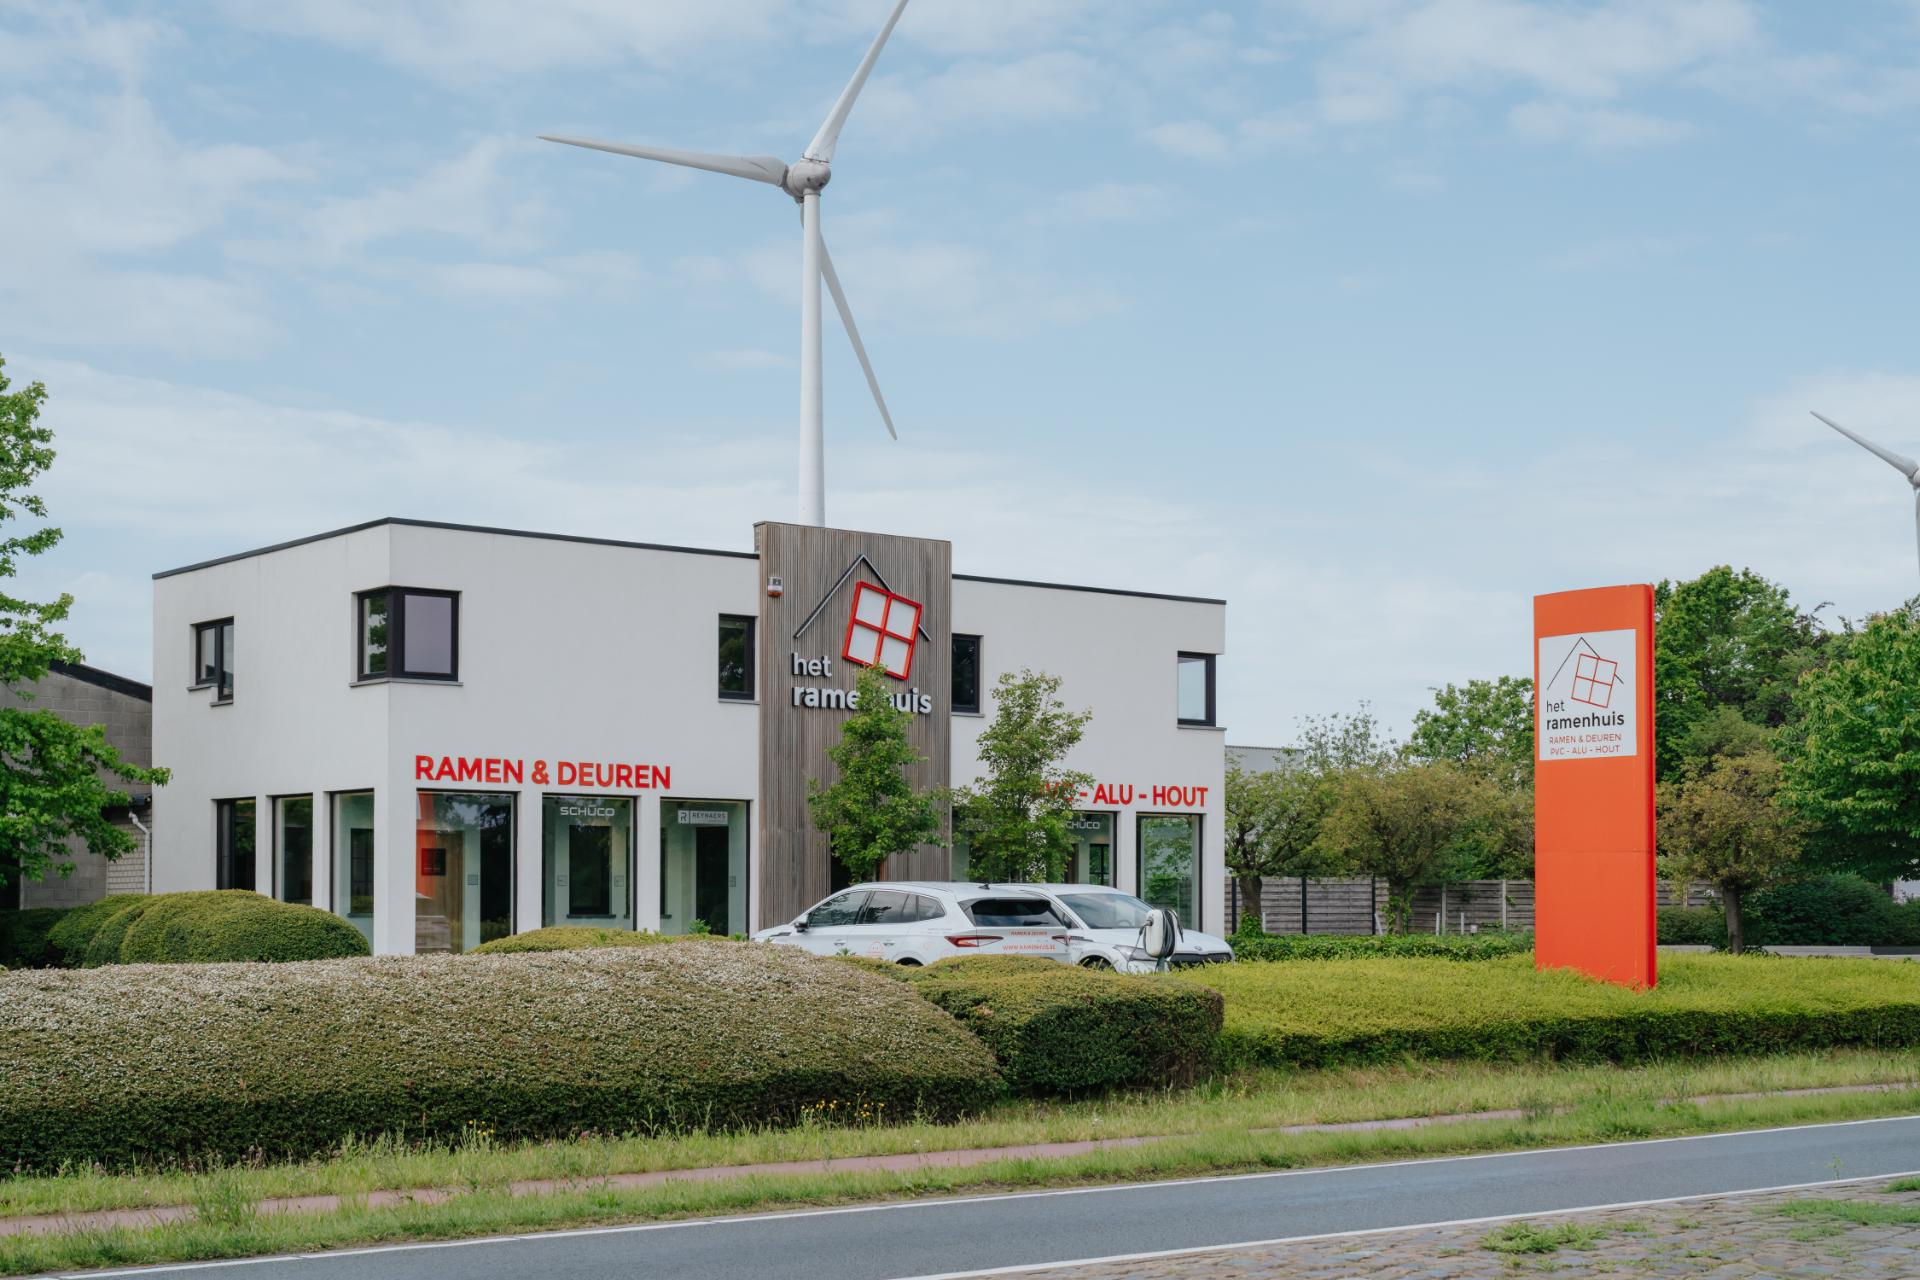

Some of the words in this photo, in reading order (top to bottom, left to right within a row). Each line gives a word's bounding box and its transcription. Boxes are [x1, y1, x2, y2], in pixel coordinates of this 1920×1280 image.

[792, 652, 832, 677] het
[792, 686, 932, 714] rameuis
[1546, 700, 1565, 712] het
[1546, 711, 1624, 730] ramenhuis
[1549, 735, 1576, 744] RAMEN
[1586, 733, 1621, 742] DEUREN
[1550, 747, 1565, 755] PVC
[1572, 746, 1587, 754] ALU
[1596, 745, 1620, 753] HOUT
[415, 755, 523, 784] RAMEN
[531, 759, 550, 785] &
[557, 761, 671, 790] DEUREN
[1092, 783, 1133, 805] ALU
[1152, 785, 1209, 807] HOUT
[560, 804, 615, 817] SCHÜCO
[1063, 818, 1100, 829] CHÜCO
